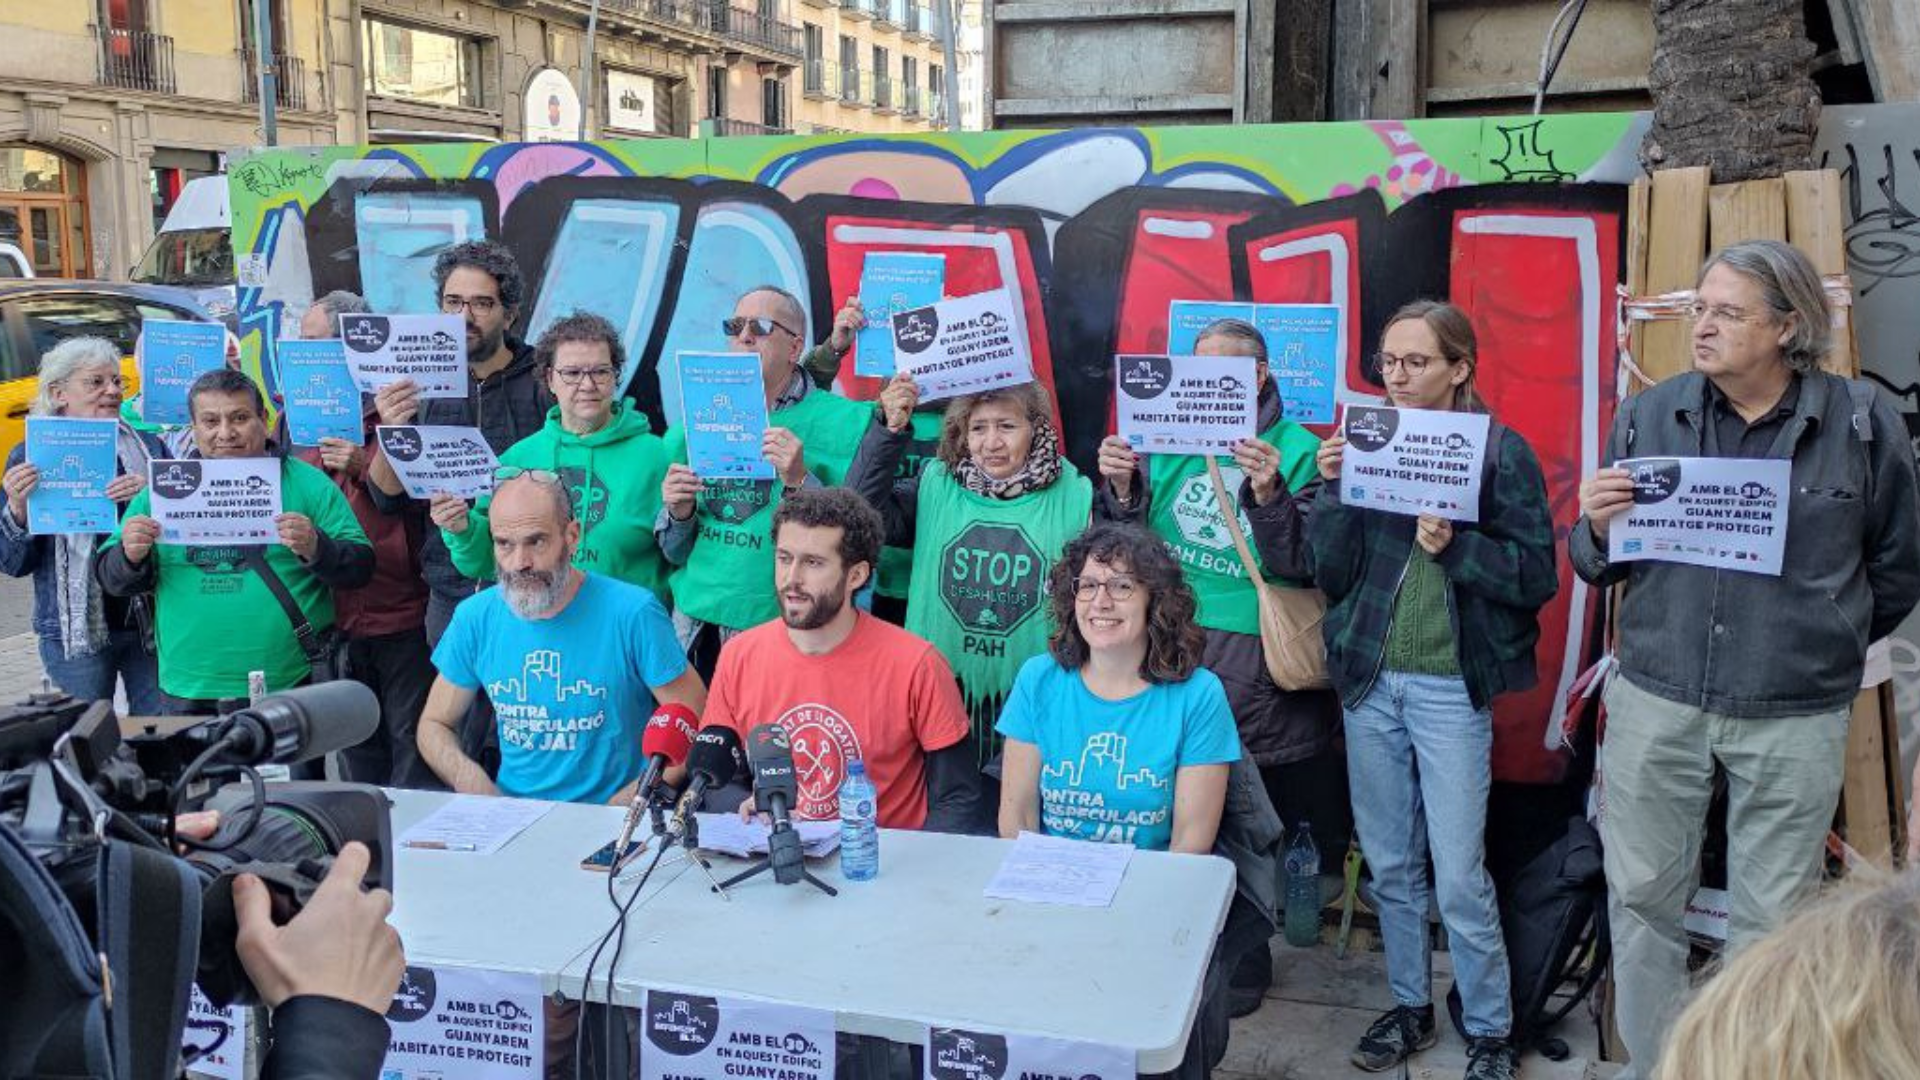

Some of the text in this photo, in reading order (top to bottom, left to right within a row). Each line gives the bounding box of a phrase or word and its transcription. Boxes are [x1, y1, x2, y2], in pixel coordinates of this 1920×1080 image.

[1179, 379, 1203, 389] AMB
[1206, 379, 1218, 389] EL
[1176, 402, 1245, 412] GUANYAREM
[1133, 413, 1247, 425] HABITATGE PROTEGIT
[1403, 434, 1429, 444] AMB
[1431, 435, 1445, 445] EL
[1398, 457, 1469, 473] GUANYAREM
[1355, 465, 1470, 487] HABITATGE PROTEGIT
[1690, 484, 1721, 495] AMB
[1724, 485, 1739, 496] EL
[1678, 497, 1777, 508] EN AQUEST EDIFICI
[1686, 508, 1772, 521] GUANYAREM
[1628, 517, 1774, 537] HABITATGE PROTEGIT
[723, 527, 764, 550] BCN
[952, 547, 1031, 588] STOP
[1199, 552, 1243, 578] BCN
[950, 584, 1028, 606] DESAHUCIOS
[964, 635, 1006, 658] PAH
[539, 732, 577, 751] JA!
[1041, 788, 1105, 807] ONTRA
[447, 1000, 476, 1013] AMB
[479, 1002, 496, 1015] EL
[437, 1014, 532, 1034] EN AQUEST EDIFICI
[444, 1029, 529, 1050] GUANYAREM
[729, 1032, 761, 1046] AMB
[765, 1036, 782, 1049] EL
[388, 1041, 532, 1068] HABITATGE PROTEGIT
[717, 1047, 822, 1070] EN AQUEST EDIFICI
[725, 1063, 818, 1080] GUANYAREM
